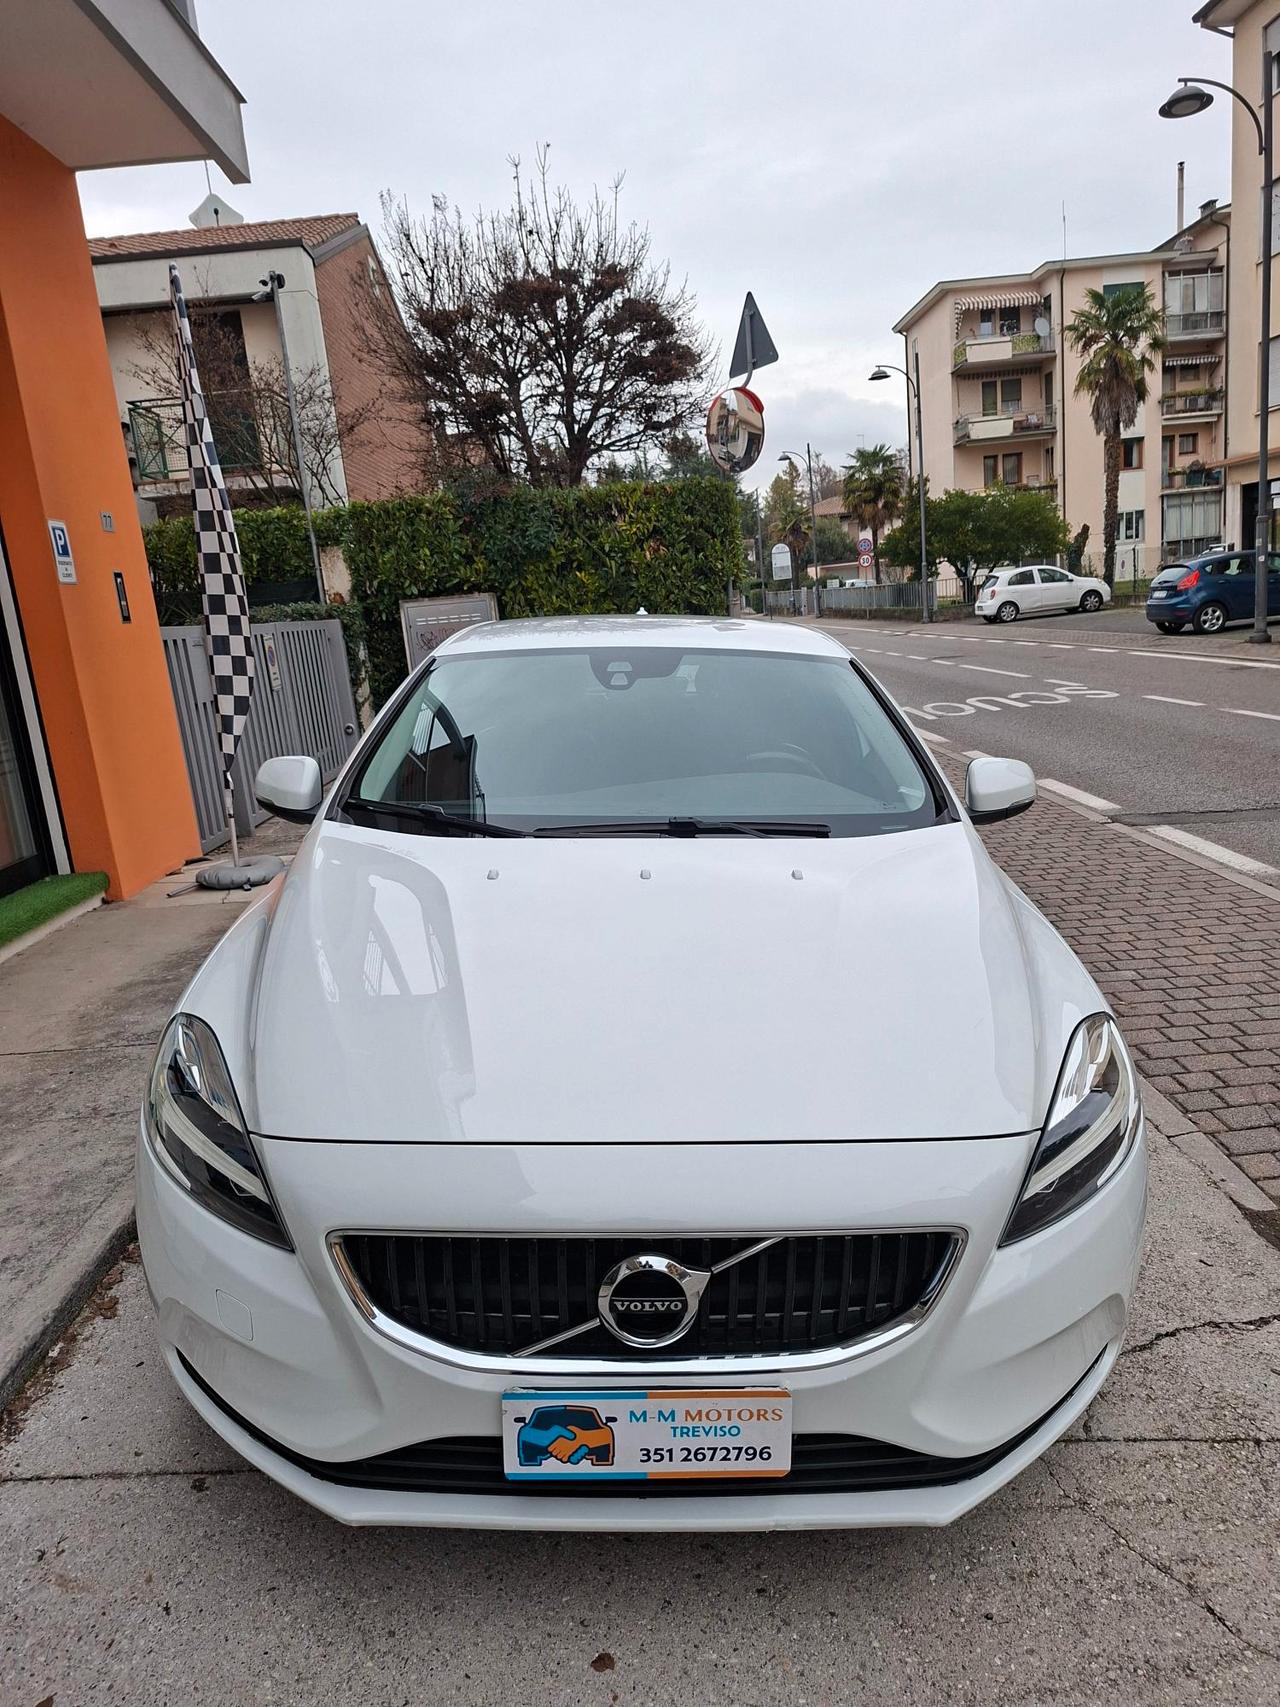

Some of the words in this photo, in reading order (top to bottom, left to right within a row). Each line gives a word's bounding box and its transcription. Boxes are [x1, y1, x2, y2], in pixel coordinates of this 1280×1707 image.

[55, 528, 65, 554] P
[613, 1301, 682, 1311] VOLVO
[629, 1408, 676, 1423] M-M
[684, 1408, 783, 1422] MOTORS
[671, 1425, 741, 1438] TREVISO
[639, 1448, 674, 1463] 351
[680, 1446, 772, 1462] 2672796
